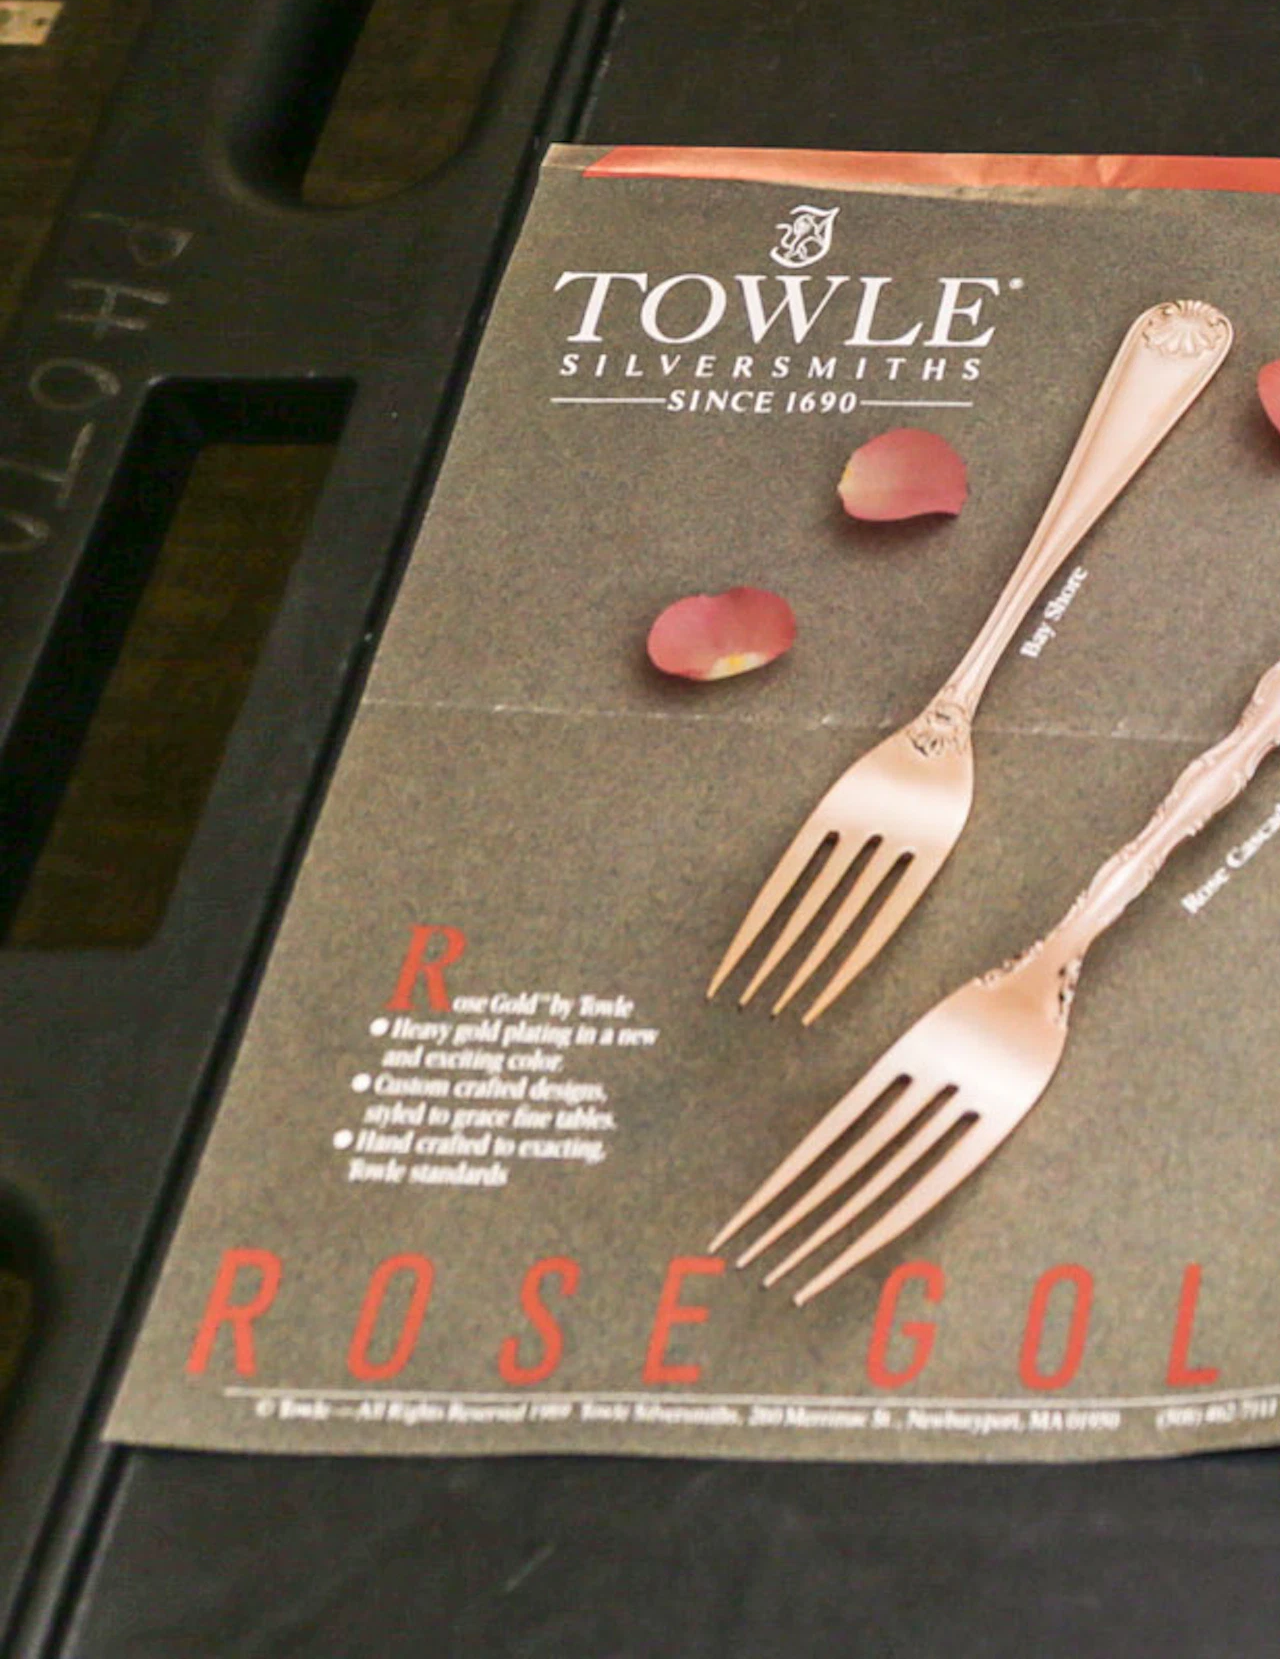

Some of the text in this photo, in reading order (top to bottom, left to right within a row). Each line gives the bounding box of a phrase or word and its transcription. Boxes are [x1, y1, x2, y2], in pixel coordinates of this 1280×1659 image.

[559, 352, 982, 381] SILVERSMITHS
[667, 388, 858, 414] SINCE 1690
[1020, 565, 1089, 658] Bay Shore
[550, 994, 575, 1021] by
[390, 1017, 661, 1048] Heavy gold plating in a new
[381, 1045, 425, 1069] and
[424, 1049, 506, 1075] exciting
[373, 1072, 451, 1097] Custom
[452, 1076, 528, 1101] crafted
[427, 1104, 451, 1128] to
[355, 1130, 415, 1155] Hand
[414, 1132, 492, 1157] crafted
[492, 1135, 516, 1157] to
[186, 1247, 726, 1387] ROSE
